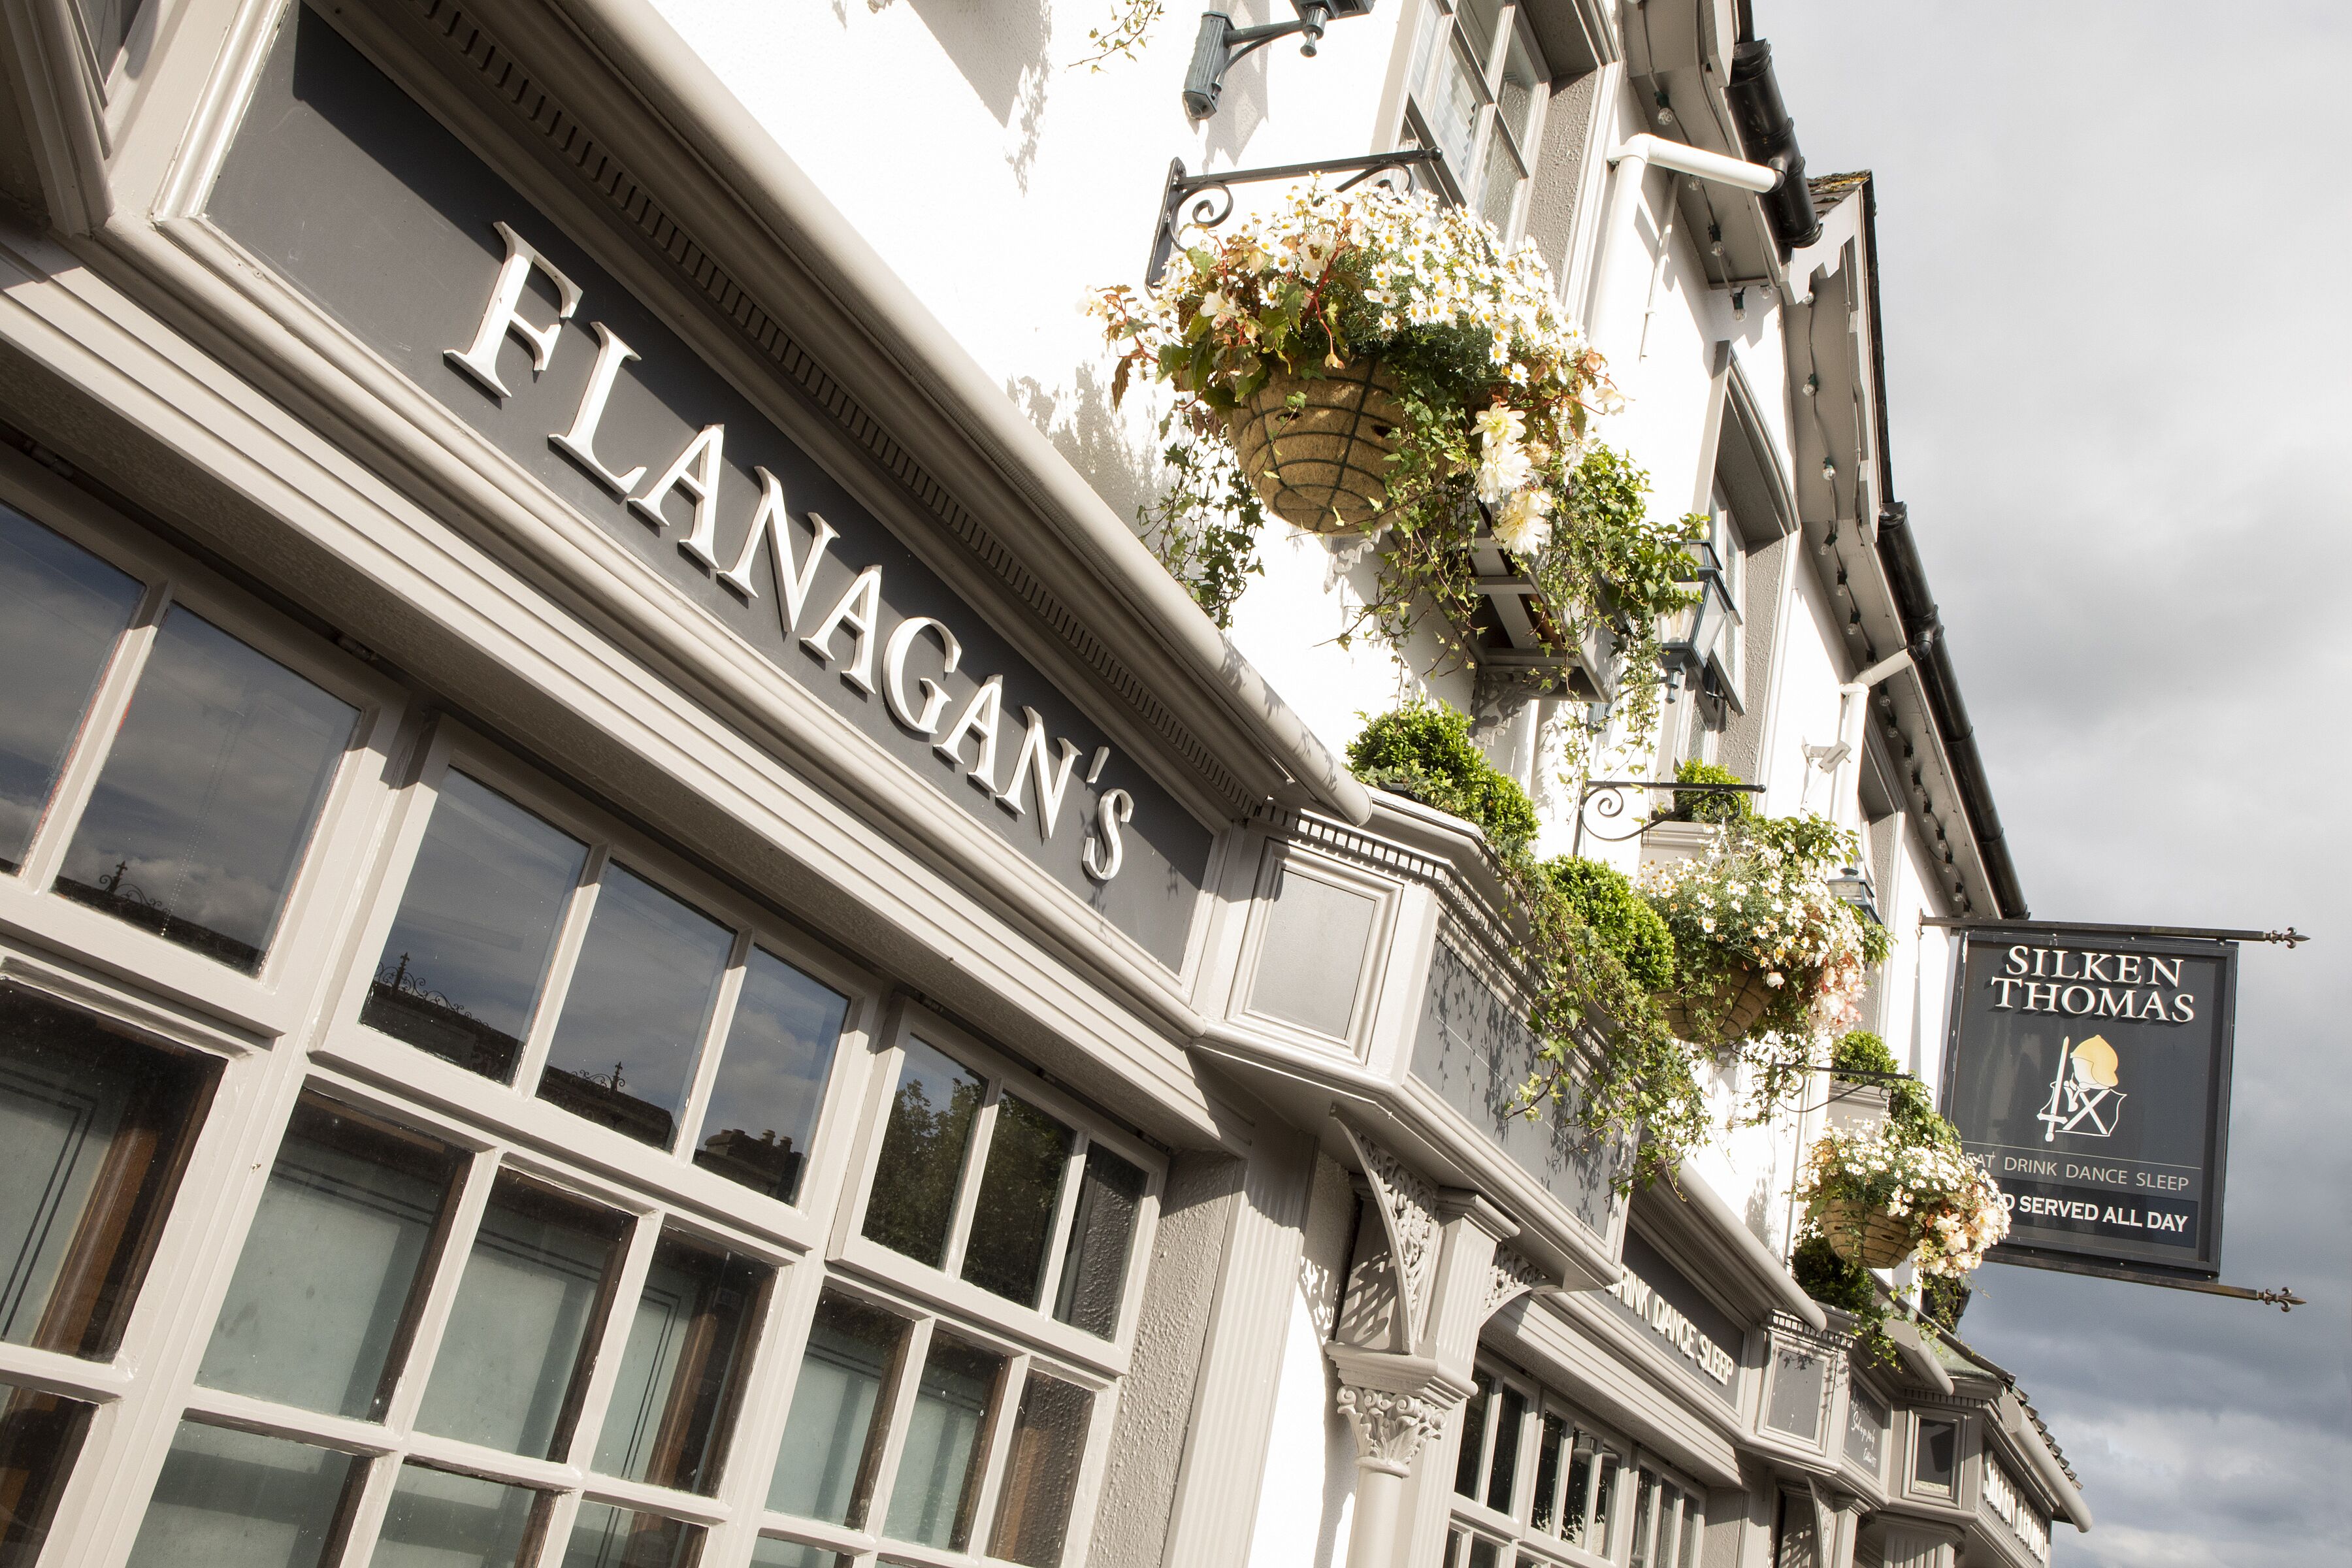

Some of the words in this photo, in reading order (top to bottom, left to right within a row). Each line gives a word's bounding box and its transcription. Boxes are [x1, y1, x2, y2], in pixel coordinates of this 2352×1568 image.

[443, 221, 1134, 880] FLANAGAN'S
[2006, 945, 2184, 988] SILKEN
[1991, 976, 2194, 1023] THOMAS
[2004, 1156, 2057, 1177] DRINK
[2065, 1164, 2128, 1184] DANCE
[2135, 1172, 2189, 1192] SLEEP
[2019, 1195, 2099, 1221] SERVED
[2102, 1206, 2143, 1228] ALL
[2147, 1211, 2189, 1233] DAY
[1651, 1294, 1697, 1360] DANCE
[1696, 1335, 1733, 1386] SLEEP
